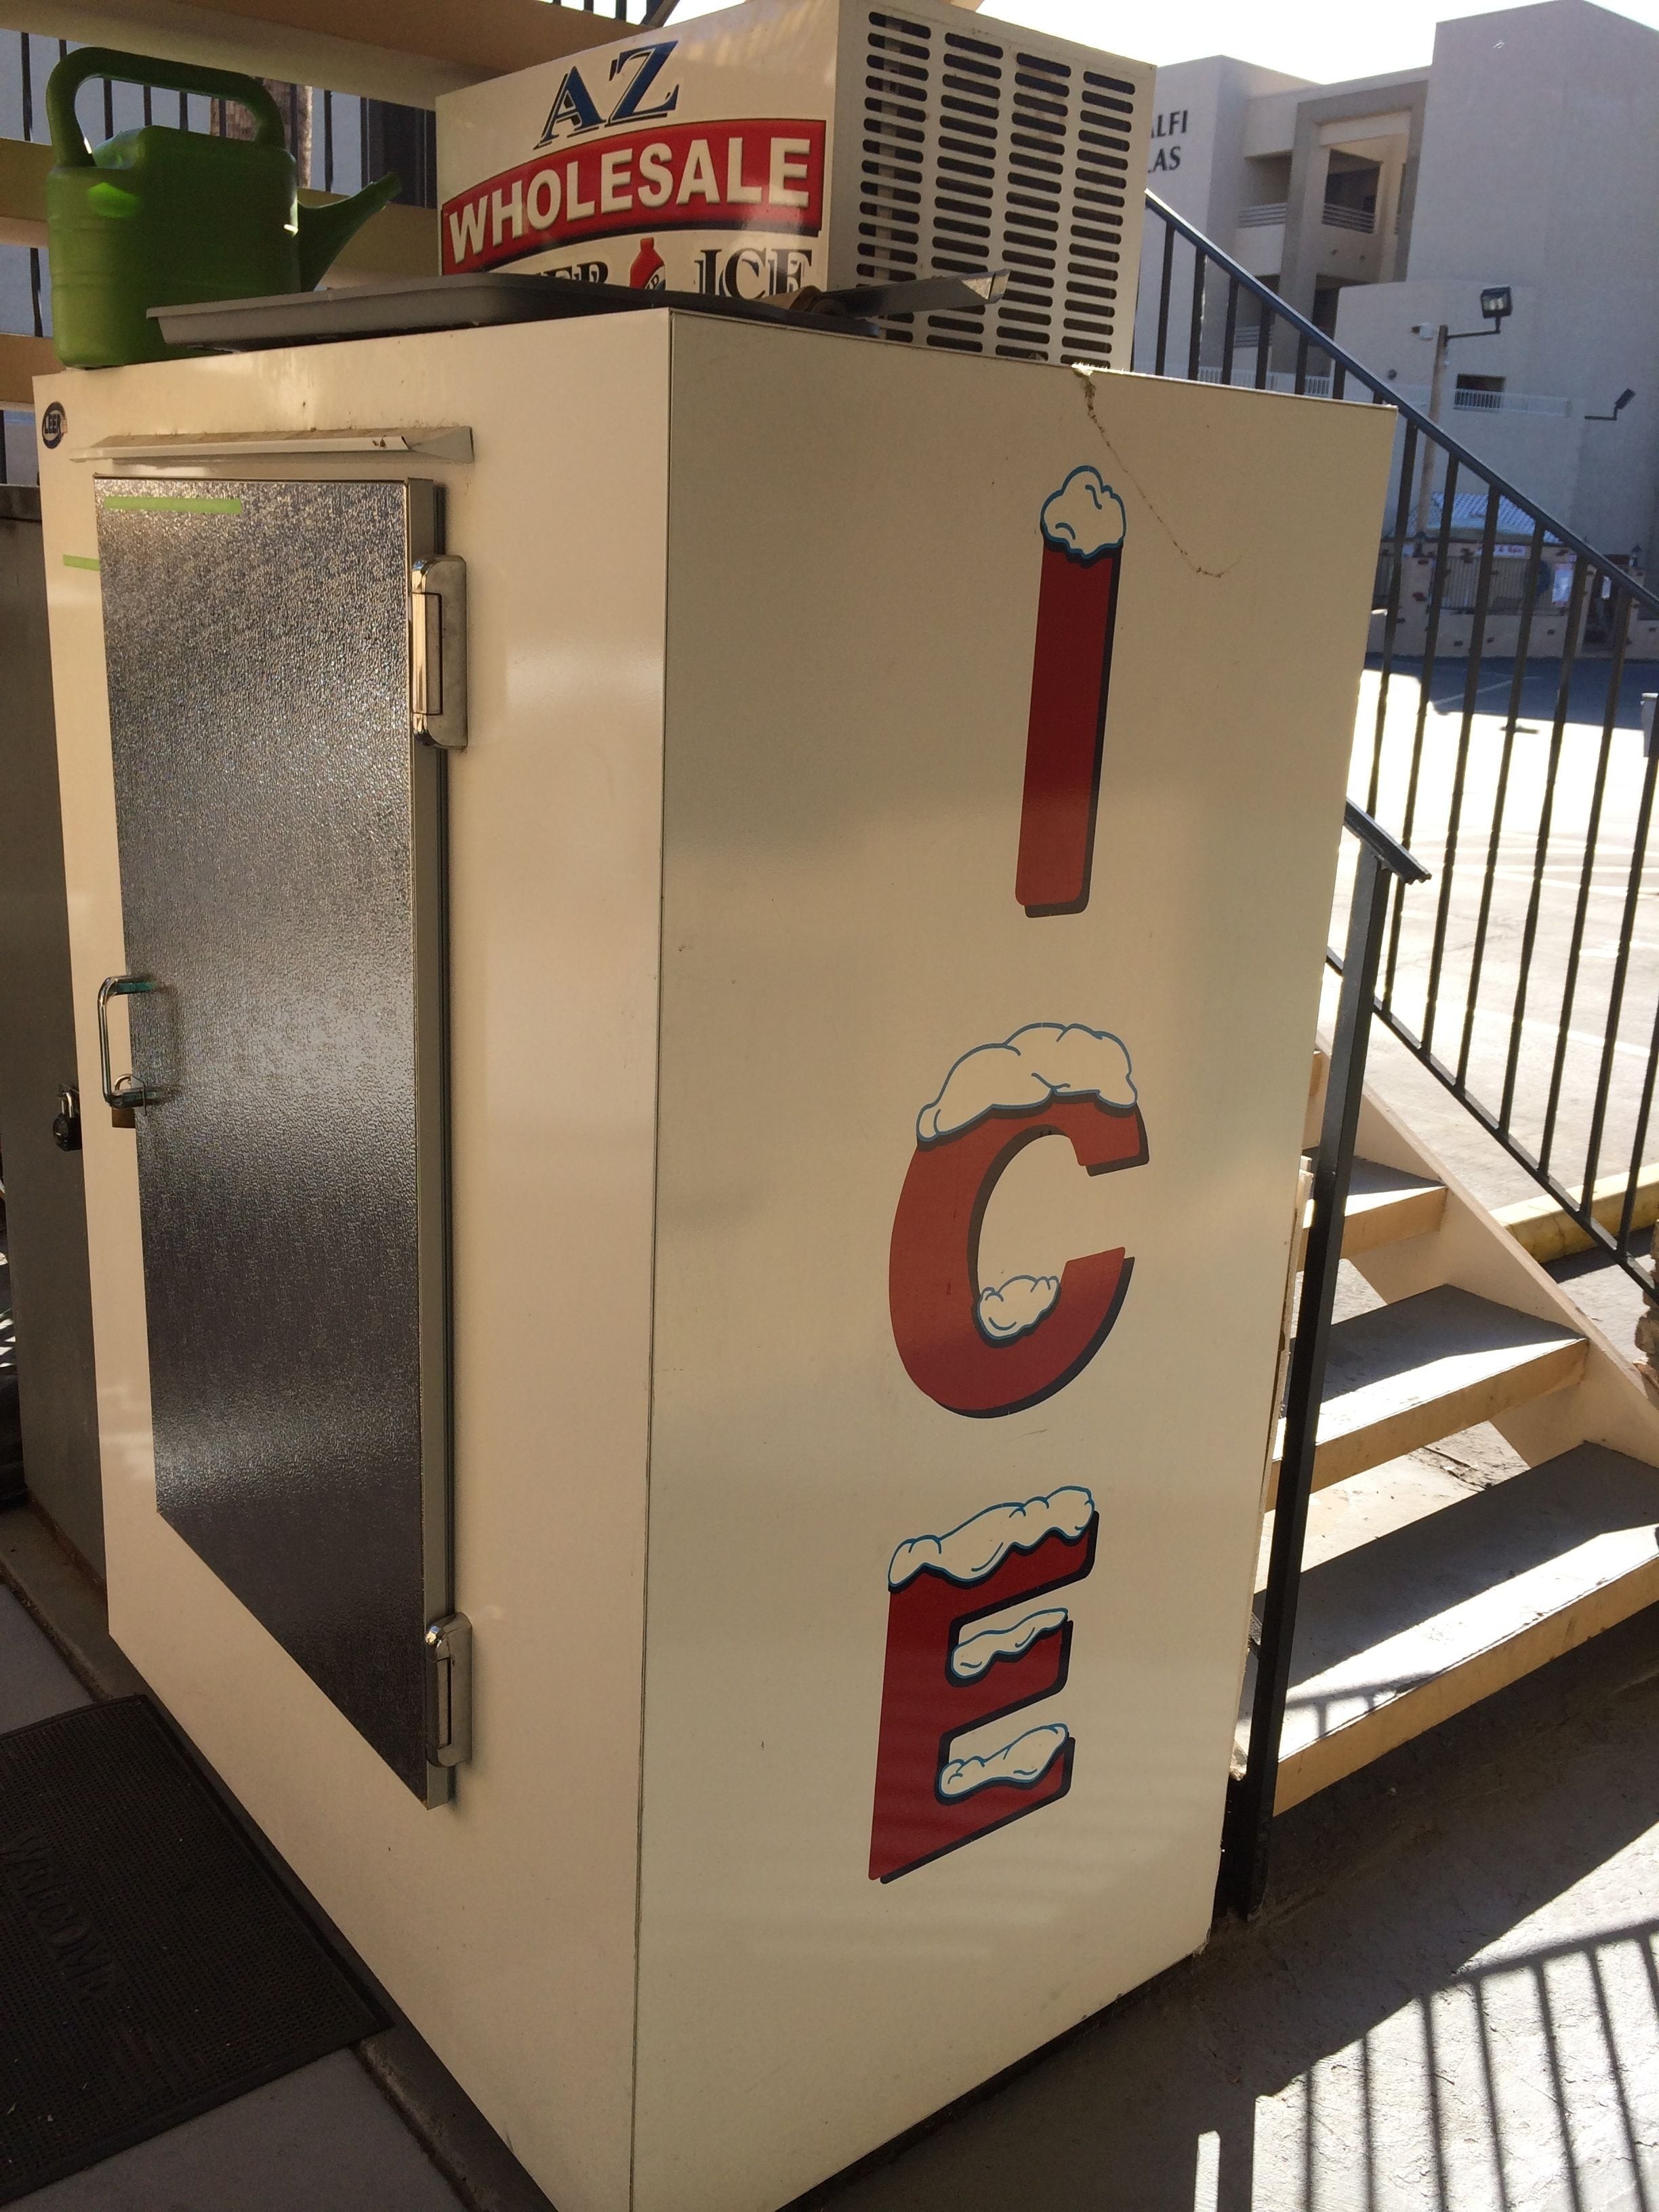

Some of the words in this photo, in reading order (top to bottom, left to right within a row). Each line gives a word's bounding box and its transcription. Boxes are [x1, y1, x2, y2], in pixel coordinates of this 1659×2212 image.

[533, 41, 679, 150] AZ
[1151, 110, 1188, 139] LFI
[449, 137, 811, 264] WHOLESALE
[1148, 146, 1181, 173] AS
[868, 464, 1149, 1884] ICE
